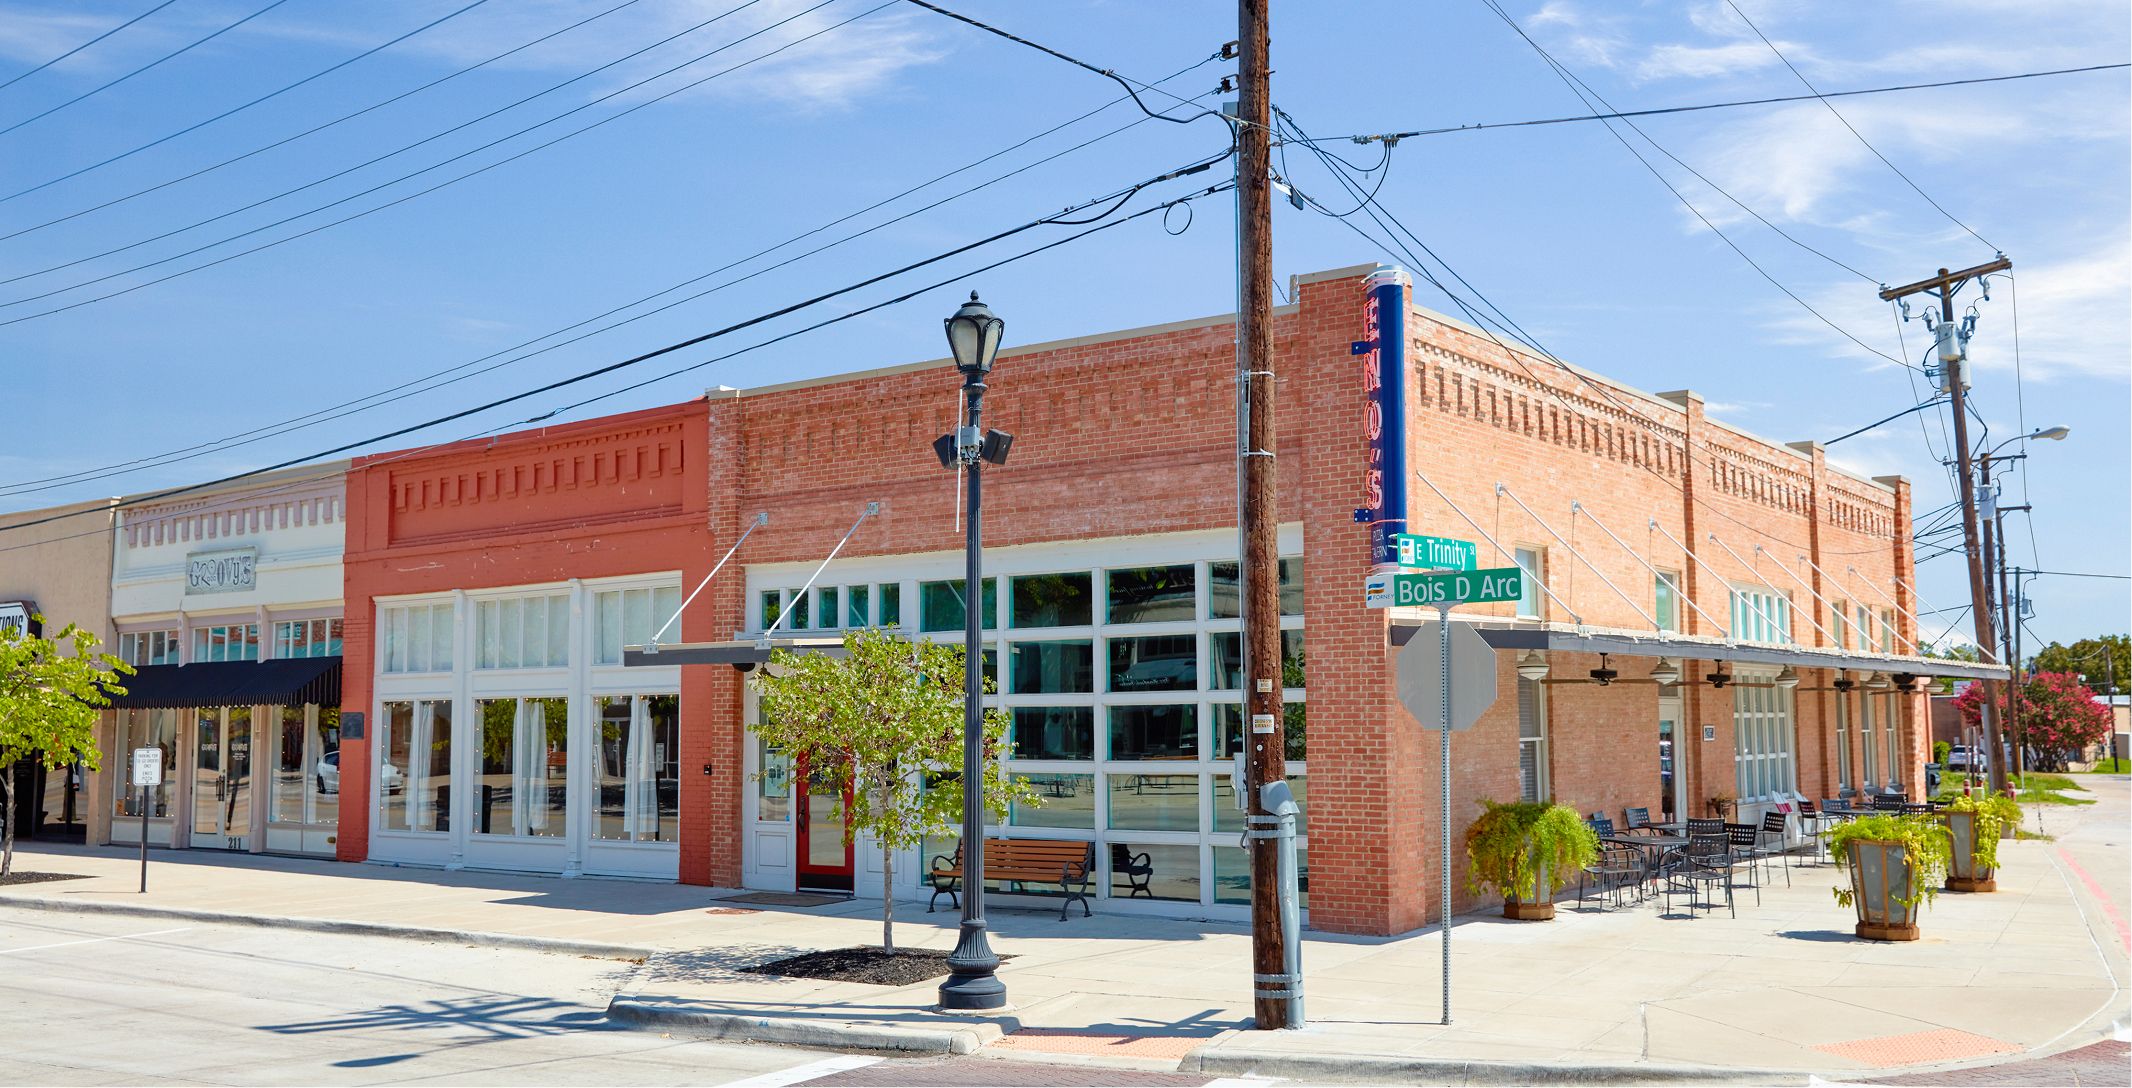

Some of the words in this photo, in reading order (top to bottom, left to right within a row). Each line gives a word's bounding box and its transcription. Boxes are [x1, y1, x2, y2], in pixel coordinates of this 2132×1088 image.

[1363, 297, 1383, 510] ENO'S
[1416, 543, 1422, 560] E
[1427, 538, 1466, 570] Trinity
[1372, 593, 1394, 601] FORNEY
[1400, 577, 1445, 603] Bois
[1456, 577, 1470, 599] D
[1480, 575, 1518, 599] Arc
[228, 837, 241, 849] 211
